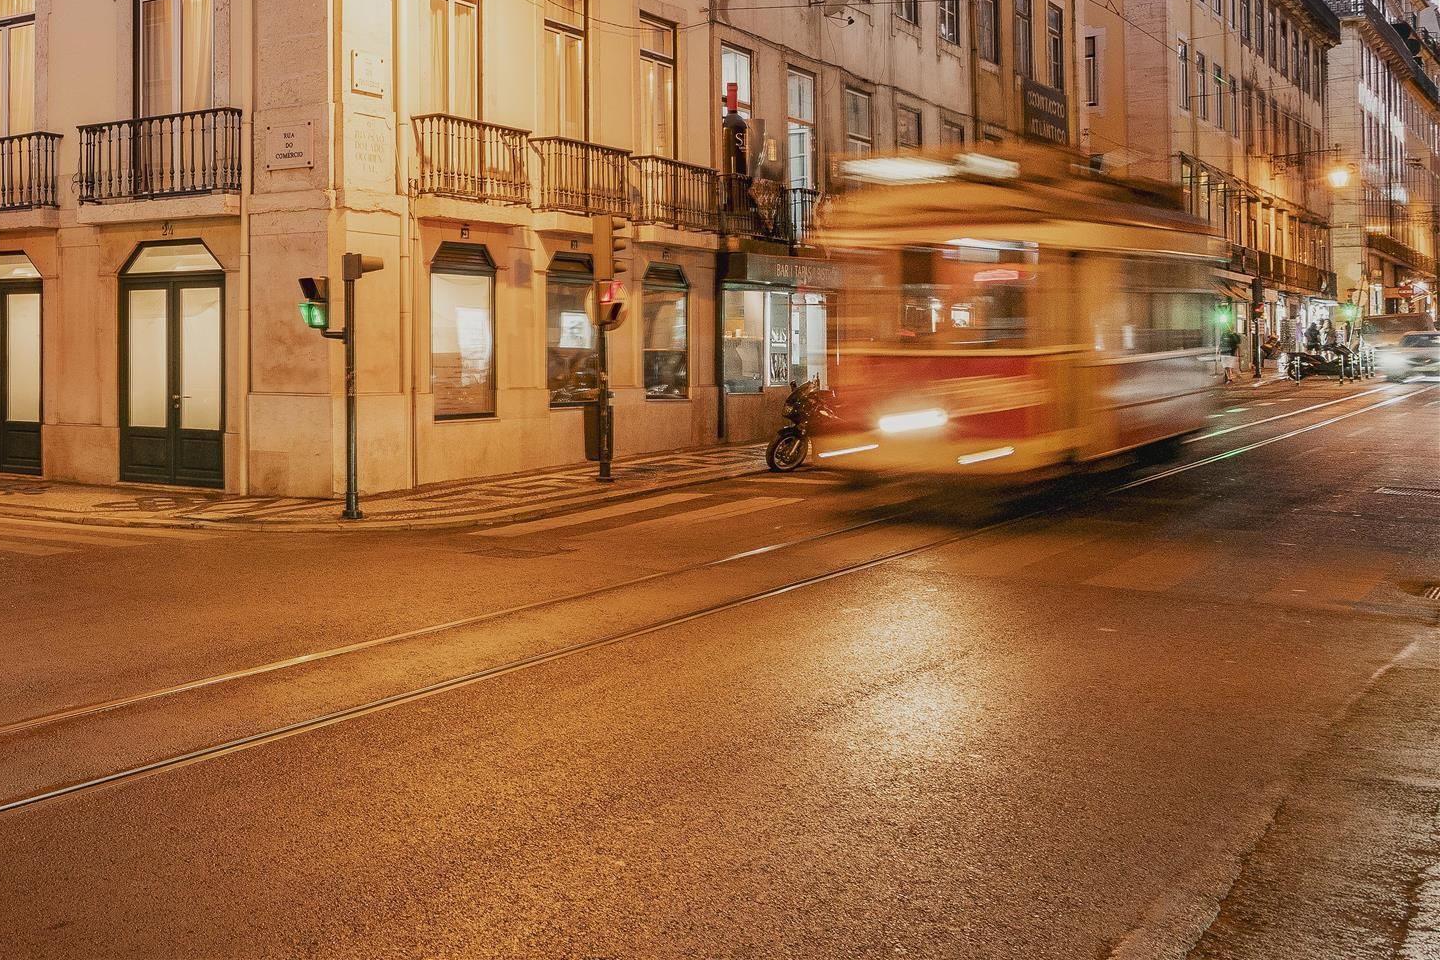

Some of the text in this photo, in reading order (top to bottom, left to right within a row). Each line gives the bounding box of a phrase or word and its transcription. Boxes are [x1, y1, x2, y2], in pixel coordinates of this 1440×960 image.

[275, 150, 304, 160] COMÉRCIO
[161, 224, 174, 236] 24
[776, 263, 789, 278] BAR
[794, 265, 812, 282] TAPAS
